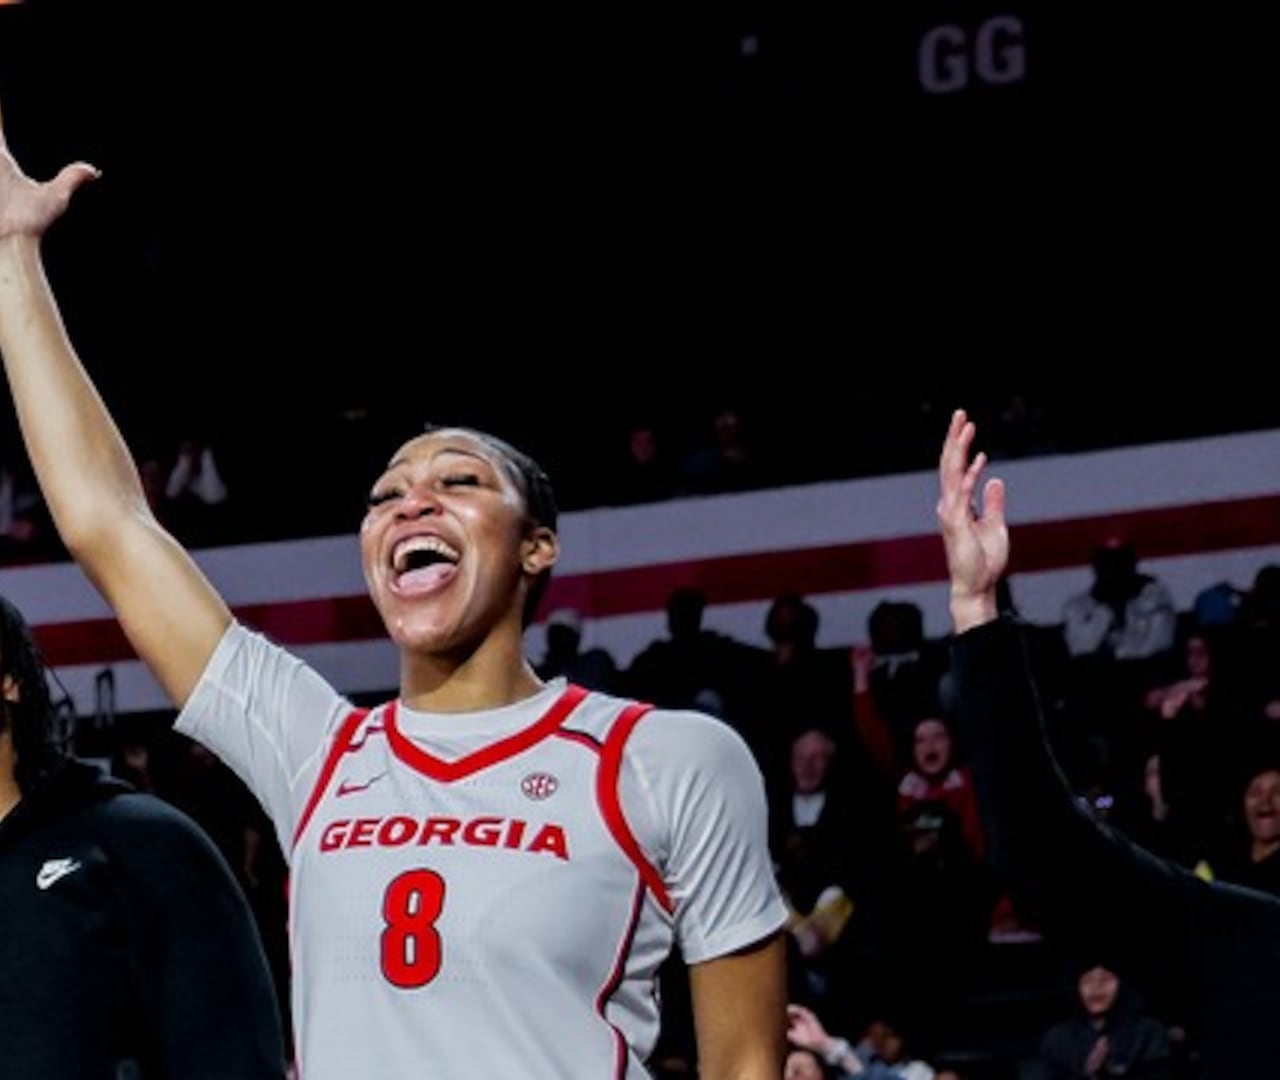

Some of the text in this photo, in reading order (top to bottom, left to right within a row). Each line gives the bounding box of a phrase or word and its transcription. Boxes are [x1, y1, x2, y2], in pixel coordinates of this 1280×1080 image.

[917, 13, 1028, 95] GG
[319, 815, 570, 862] GEORGIA
[380, 867, 447, 989] 8
